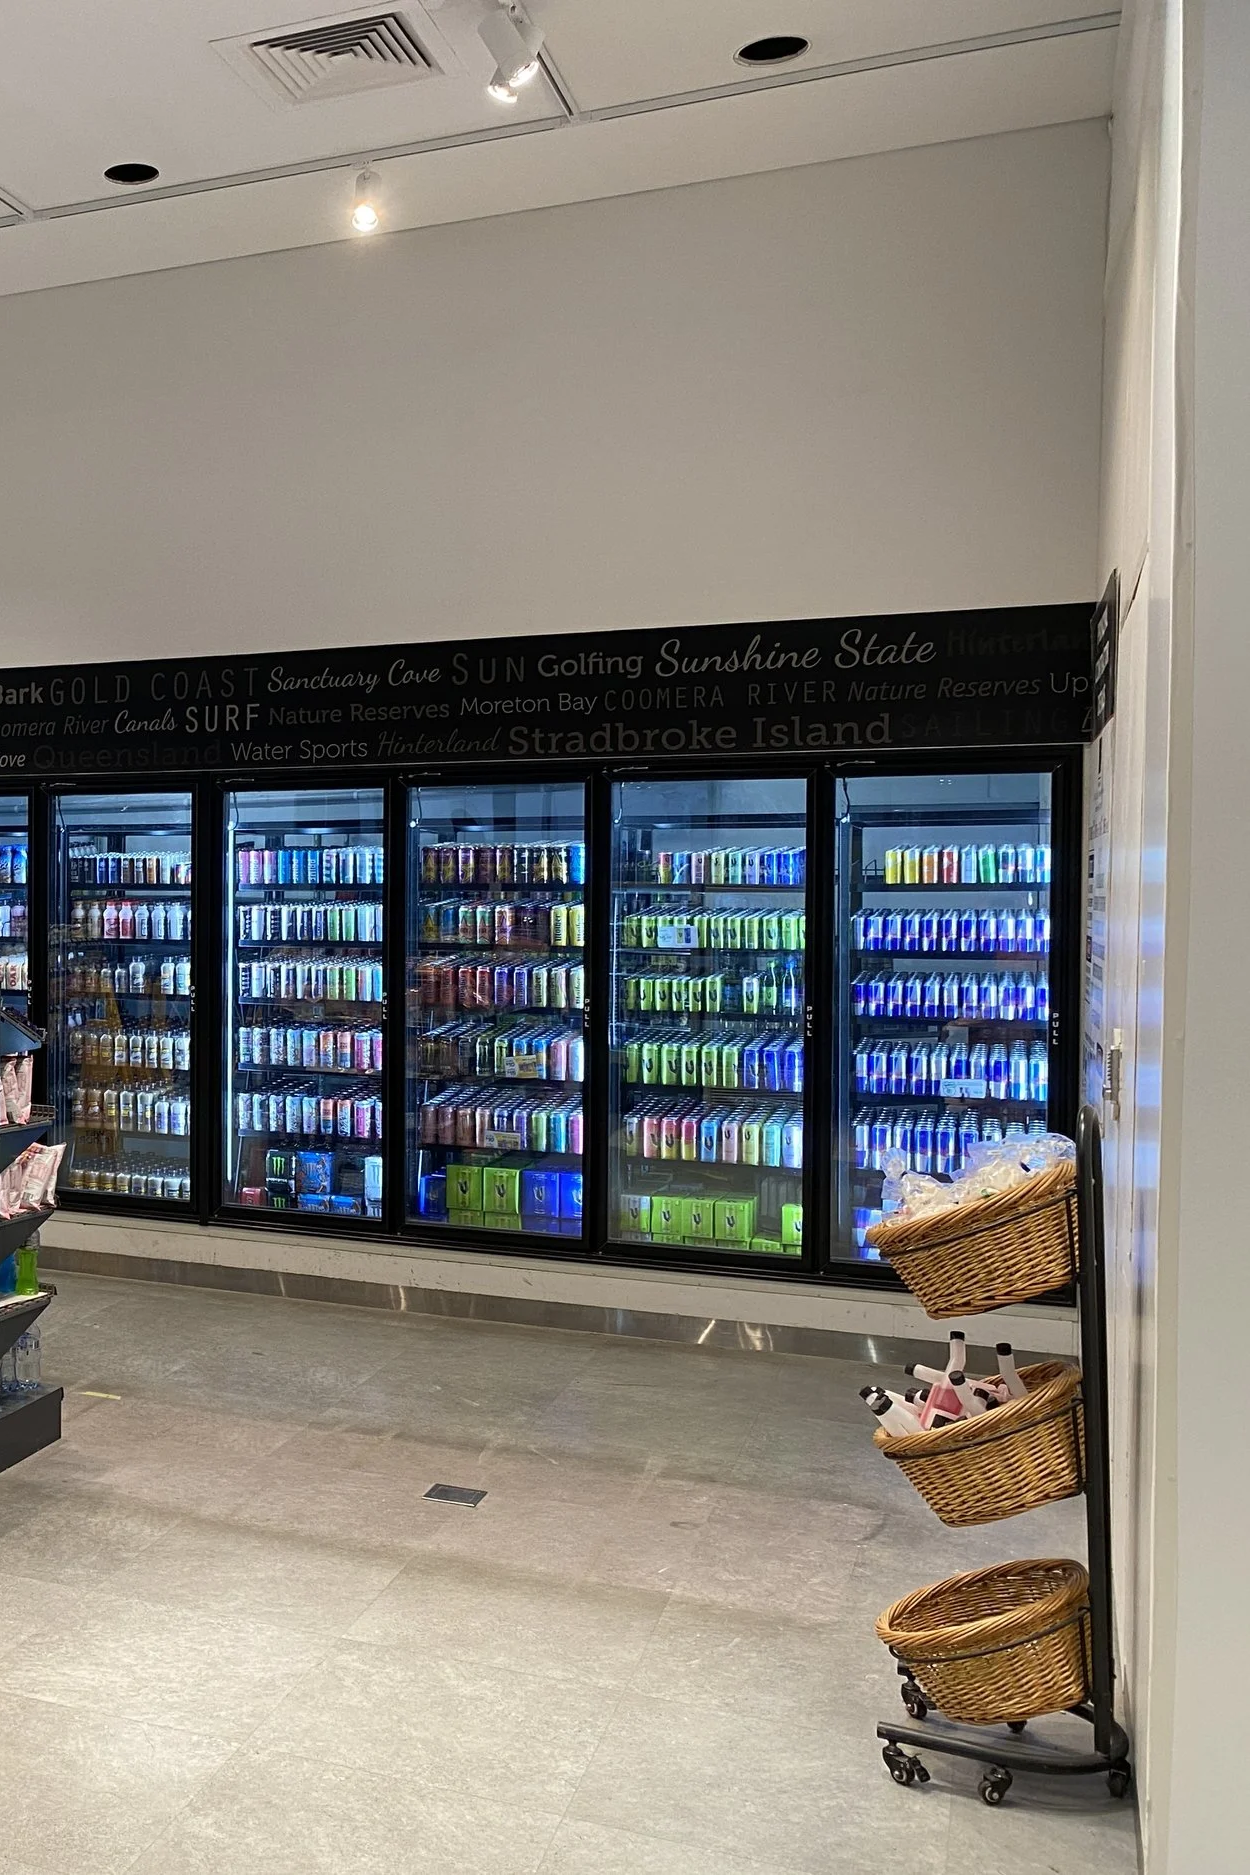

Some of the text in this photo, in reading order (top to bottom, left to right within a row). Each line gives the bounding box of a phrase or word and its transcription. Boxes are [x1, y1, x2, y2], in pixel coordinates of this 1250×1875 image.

[537, 651, 645, 680] Golfing
[654, 628, 938, 678] Sunshine State
[267, 658, 442, 693] Sanctuary Cove
[451, 652, 526, 686] SUN
[49, 667, 260, 706] GOLD COAST
[604, 680, 837, 712] COOMERA RIVER
[848, 676, 1041, 703] Nature Reserves
[1049, 672, 1090, 699] Up
[185, 703, 261, 734] SURF
[267, 700, 450, 727] Nature Reserves
[460, 692, 599, 716] Moreton Bay
[63, 714, 110, 736] River
[114, 707, 179, 735] Canals
[508, 712, 894, 756] Stradbroke Island
[32, 739, 223, 770] Queensland
[230, 738, 368, 764] Water Sports
[377, 726, 503, 758] Hinterland
